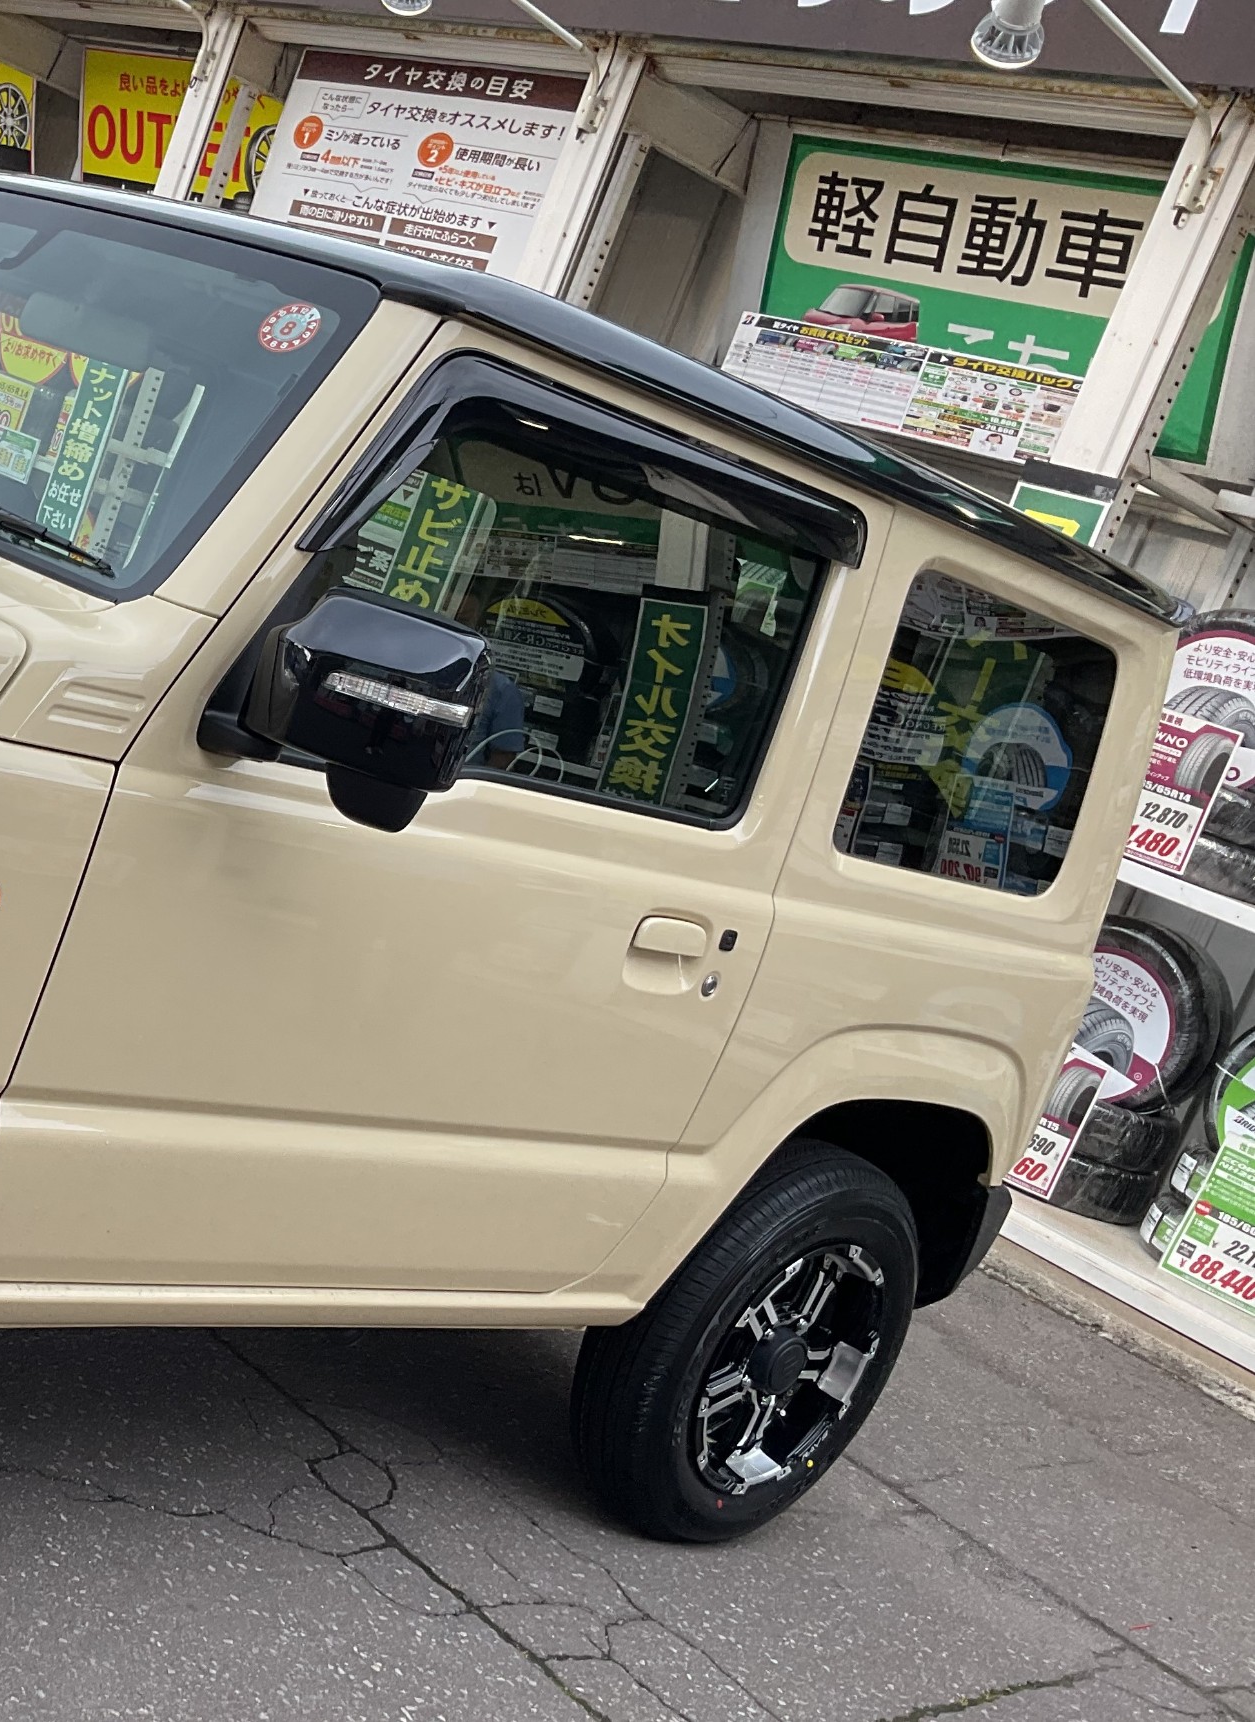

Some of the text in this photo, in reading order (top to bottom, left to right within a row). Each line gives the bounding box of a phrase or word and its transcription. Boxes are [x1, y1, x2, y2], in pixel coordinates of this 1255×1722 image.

[364, 64, 535, 100] タイヤ交換の目安
[303, 132, 310, 145] 1
[324, 129, 401, 151] ミゾが減っている
[426, 149, 439, 163] 2
[454, 147, 541, 172] 使用期間が長い
[299, 204, 374, 228] 雨の日に滑りやすい
[352, 195, 482, 229] こんな症状が出始めます
[402, 223, 477, 248] 走行中にふらつく
[808, 169, 1145, 299] 軽自動車
[279, 321, 297, 336] 8
[302, 331, 311, 339] 3
[307, 321, 317, 330] 2
[2, 339, 58, 367] よりお求めやすく
[58, 367, 116, 481] ナット増締め
[47, 480, 82, 507] お任せ
[42, 505, 72, 530] 下さい
[389, 477, 471, 609] サビ止め
[1139, 801, 1189, 830] 12,870
[1095, 955, 1160, 998] より安全・安心な
[1093, 981, 1149, 1023] 境負荷を実現
[1222, 1240, 1255, 1269] 22,1
[1189, 1254, 1255, 1301] 88,440
